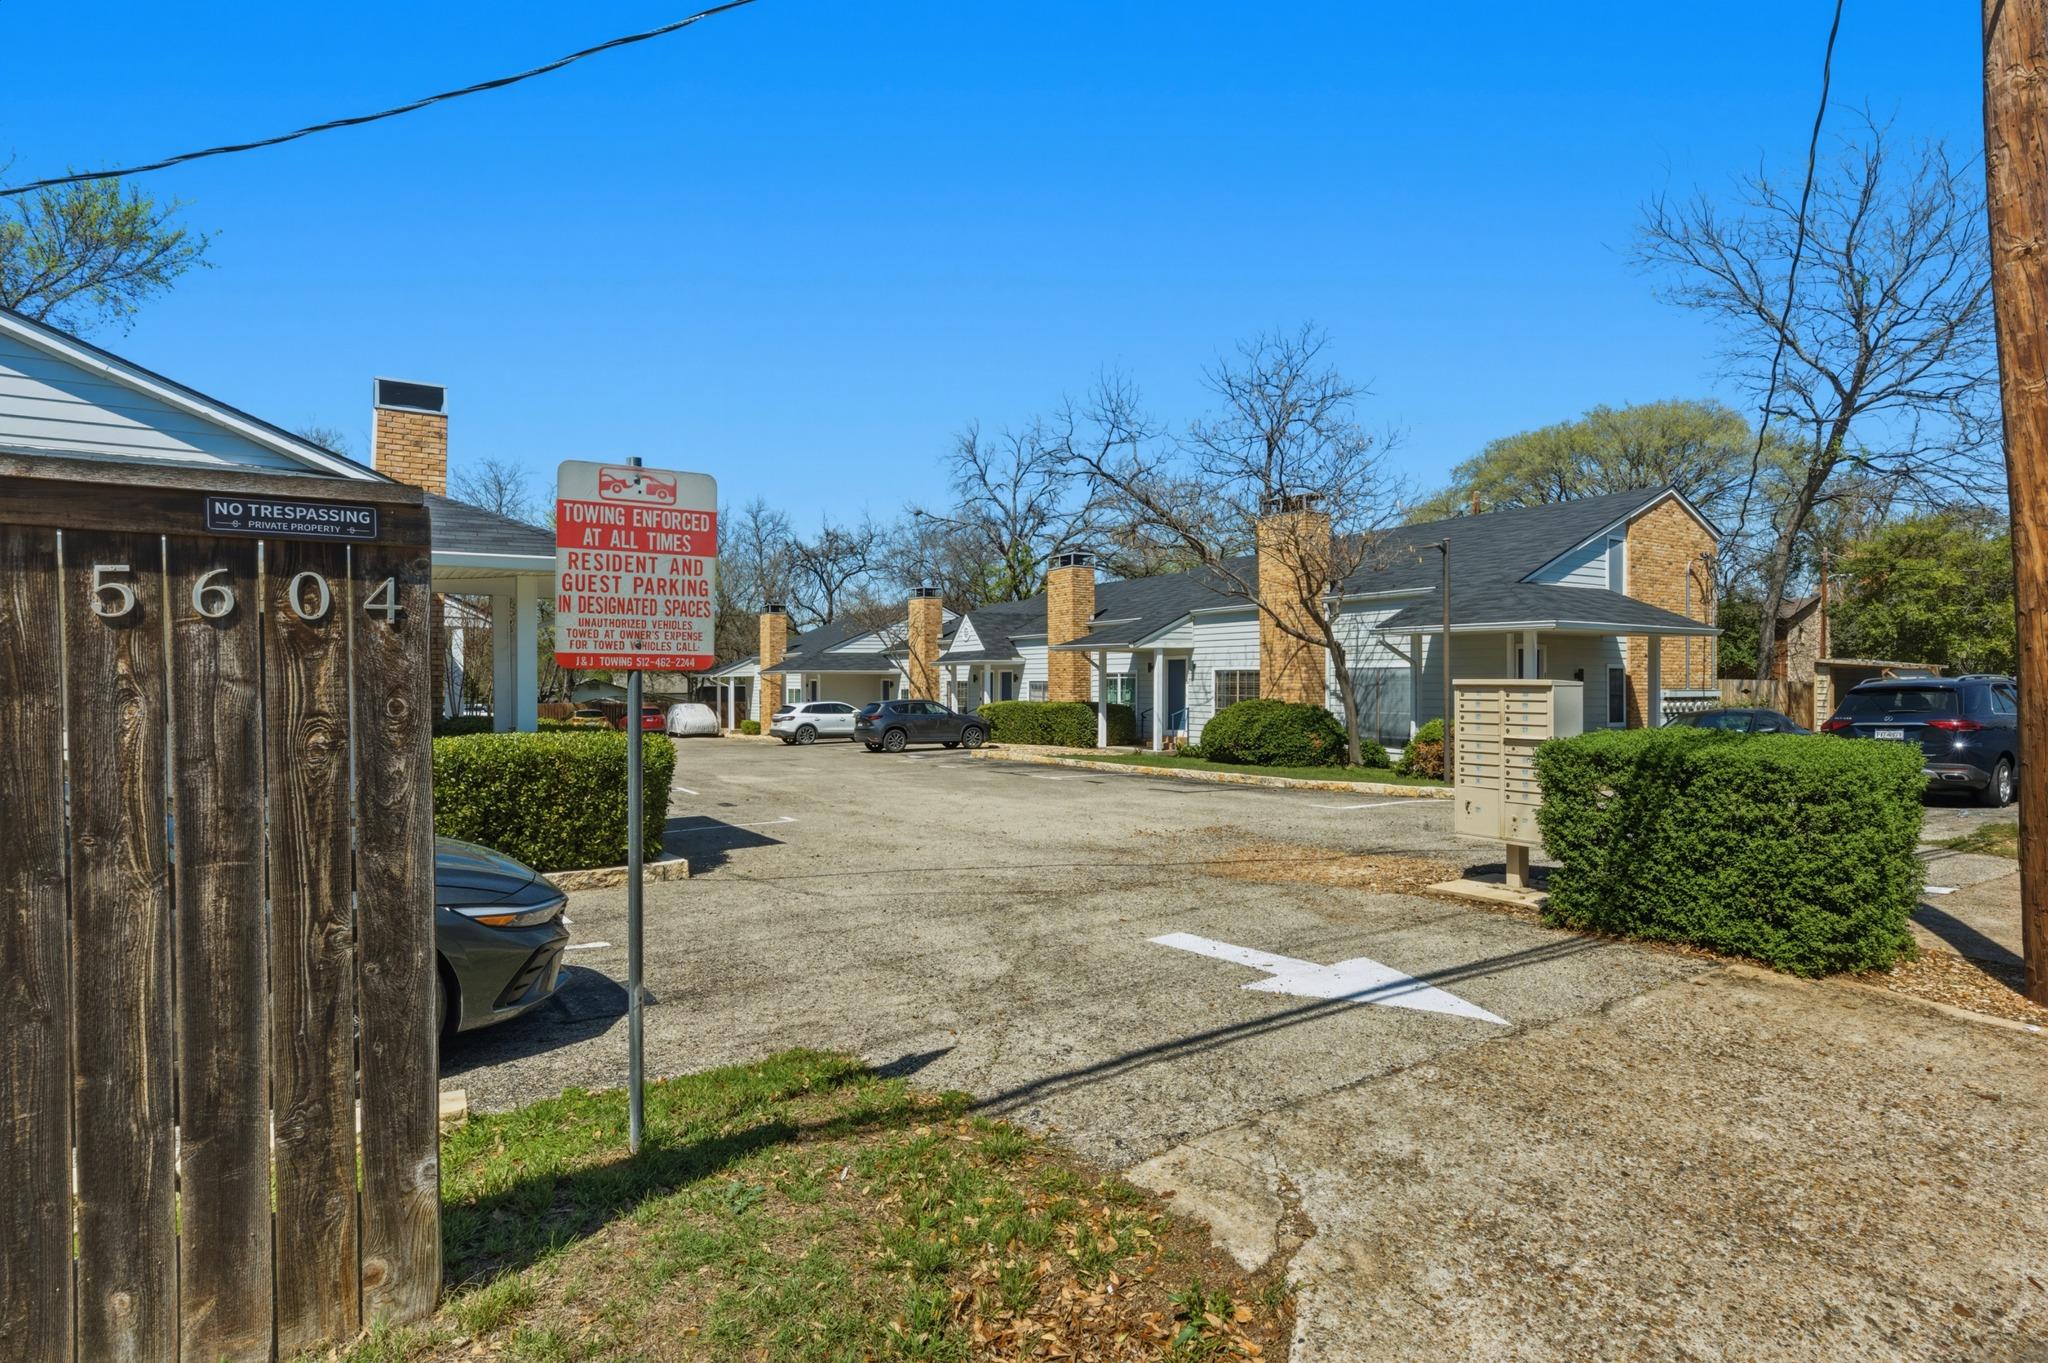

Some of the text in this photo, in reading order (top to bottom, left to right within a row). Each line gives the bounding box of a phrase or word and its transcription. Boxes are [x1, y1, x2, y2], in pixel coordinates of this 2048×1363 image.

[214, 501, 370, 524] NO TRESPASSING
[564, 503, 710, 532] TOWING ENFORCED
[248, 520, 341, 533] PRIVATE PROPERTY
[583, 527, 691, 552] AT ALL TIMES
[568, 552, 704, 576] RESIDENT AND
[562, 573, 709, 597] GUEST PARKING
[558, 594, 711, 618] IN DESIGNATED SPACES
[566, 628, 703, 642] TOWED AT OWNER'S EXPENSE
[578, 617, 693, 631] UNAUTHORIZED VEHICLES
[569, 639, 588, 650] FOR
[593, 640, 625, 650] TOWED
[630, 641, 672, 651] VHICLES
[599, 656, 632, 667] TOWING
